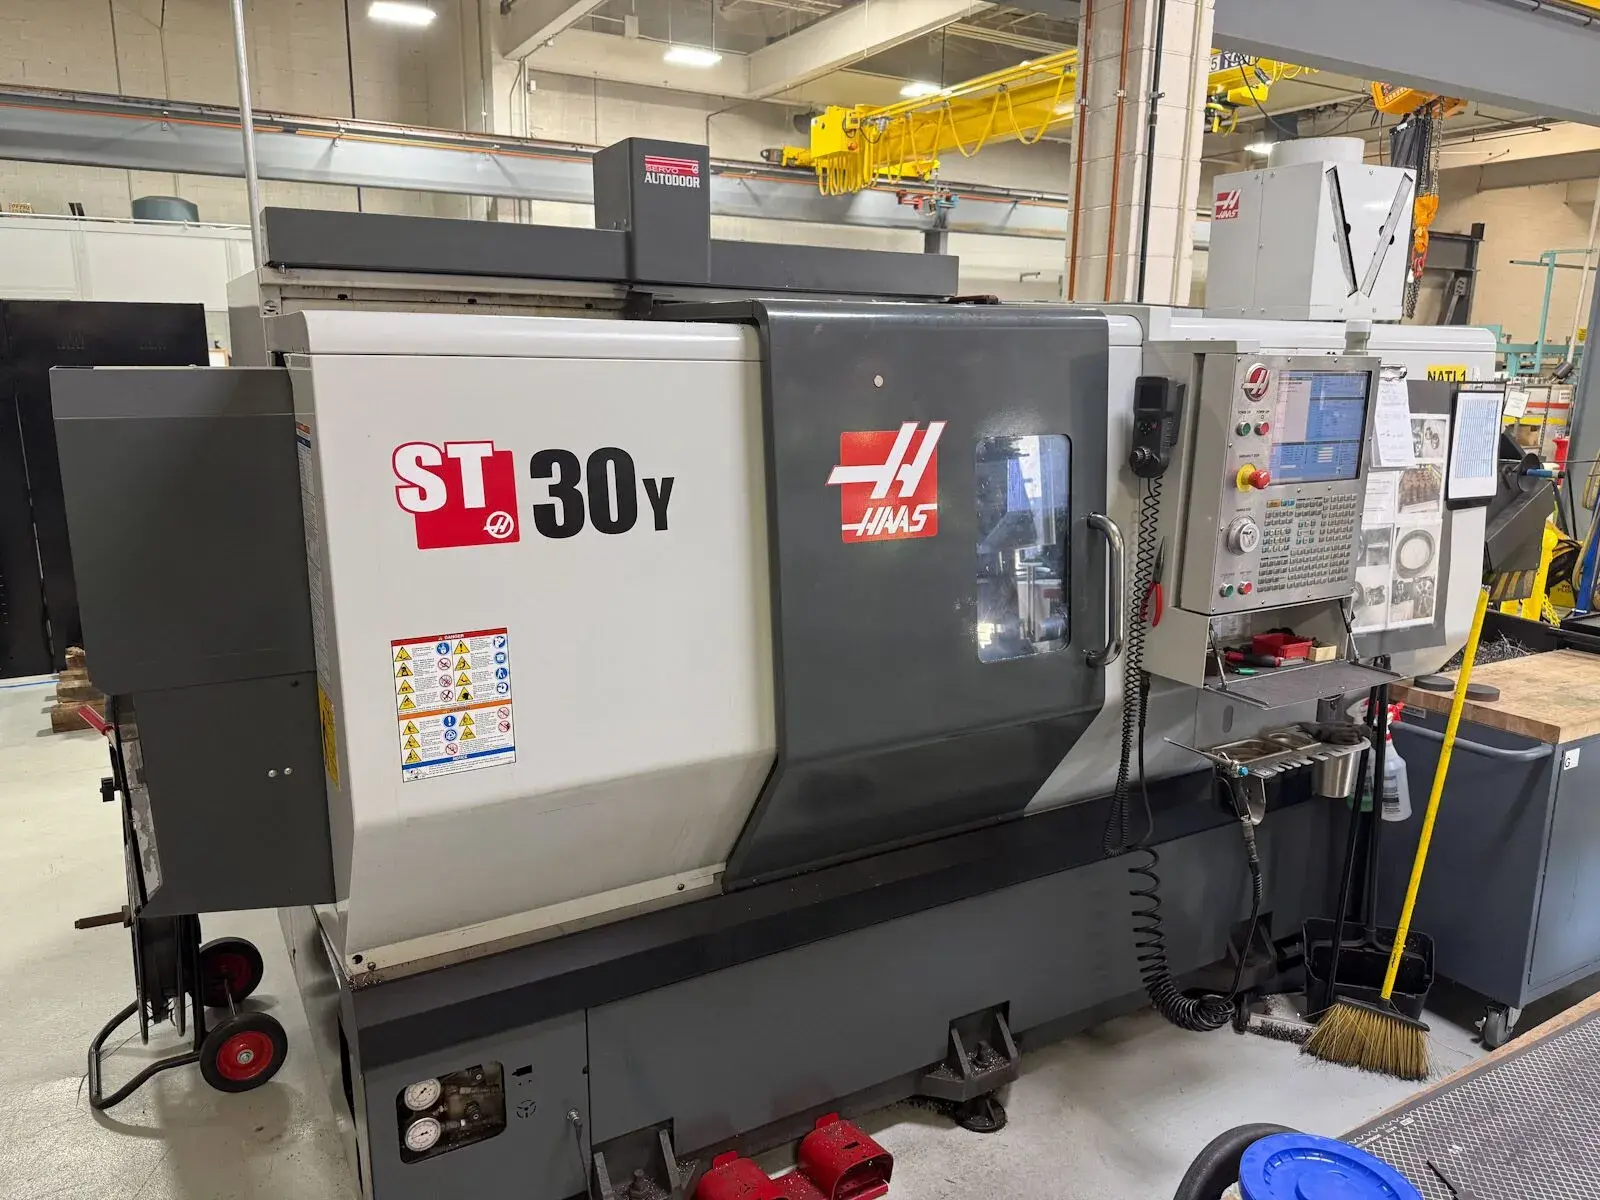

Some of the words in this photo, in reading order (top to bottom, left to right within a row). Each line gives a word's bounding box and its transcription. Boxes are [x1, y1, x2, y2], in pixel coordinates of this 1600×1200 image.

[644, 172, 700, 188] AUTODOOR
[645, 164, 679, 174] SERVO
[392, 440, 493, 515] ST
[842, 503, 938, 537] HAAS
